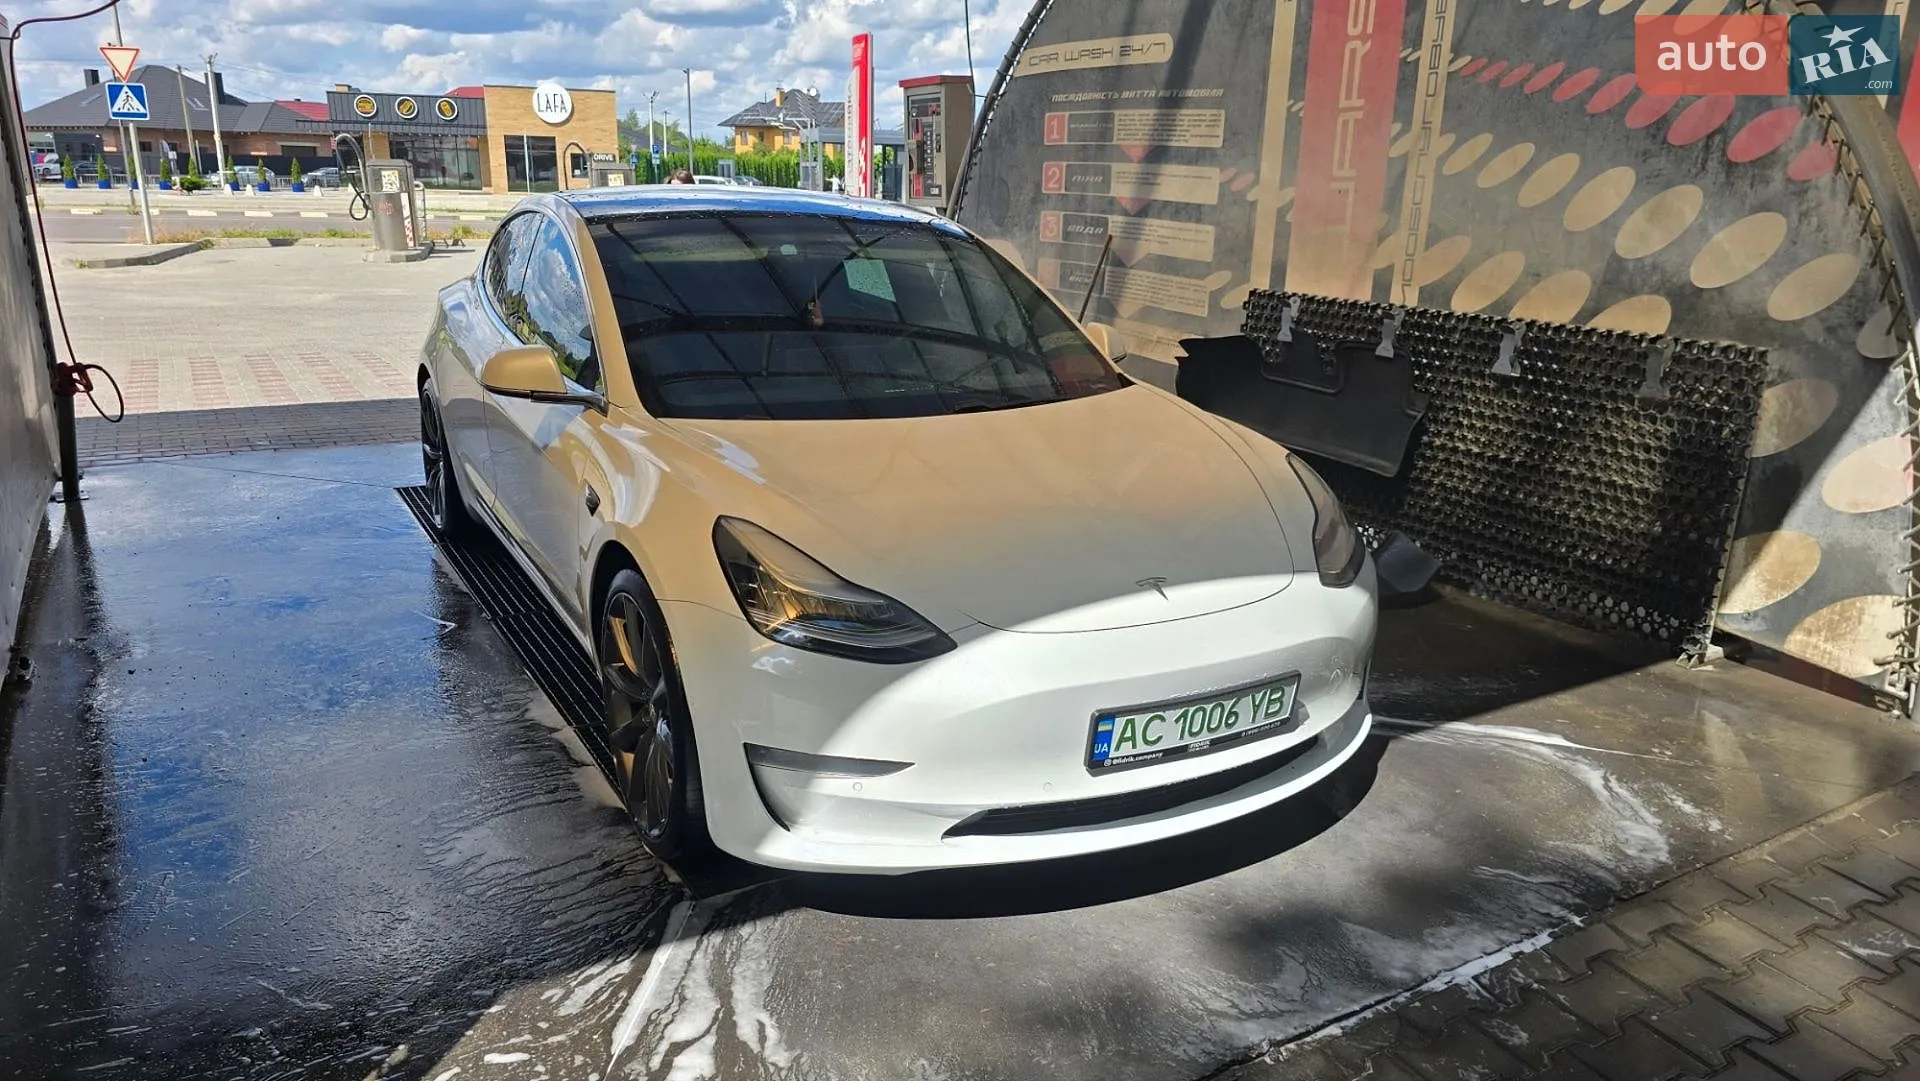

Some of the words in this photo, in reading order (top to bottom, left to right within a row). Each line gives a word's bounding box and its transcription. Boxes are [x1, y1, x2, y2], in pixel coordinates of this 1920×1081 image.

[1028, 53, 1060, 67] CAR
[1064, 46, 1114, 62] WASH
[1119, 42, 1167, 58] 24/7
[537, 93, 568, 113] LAFA
[1050, 119, 1060, 139] 1
[593, 153, 614, 161] DRIVE
[1048, 167, 1061, 188] 2
[1045, 216, 1057, 237] 3
[1114, 713, 1167, 752] AC
[1173, 697, 1240, 741] 1006
[1249, 686, 1286, 723] YB
[1094, 744, 1109, 755] UA
